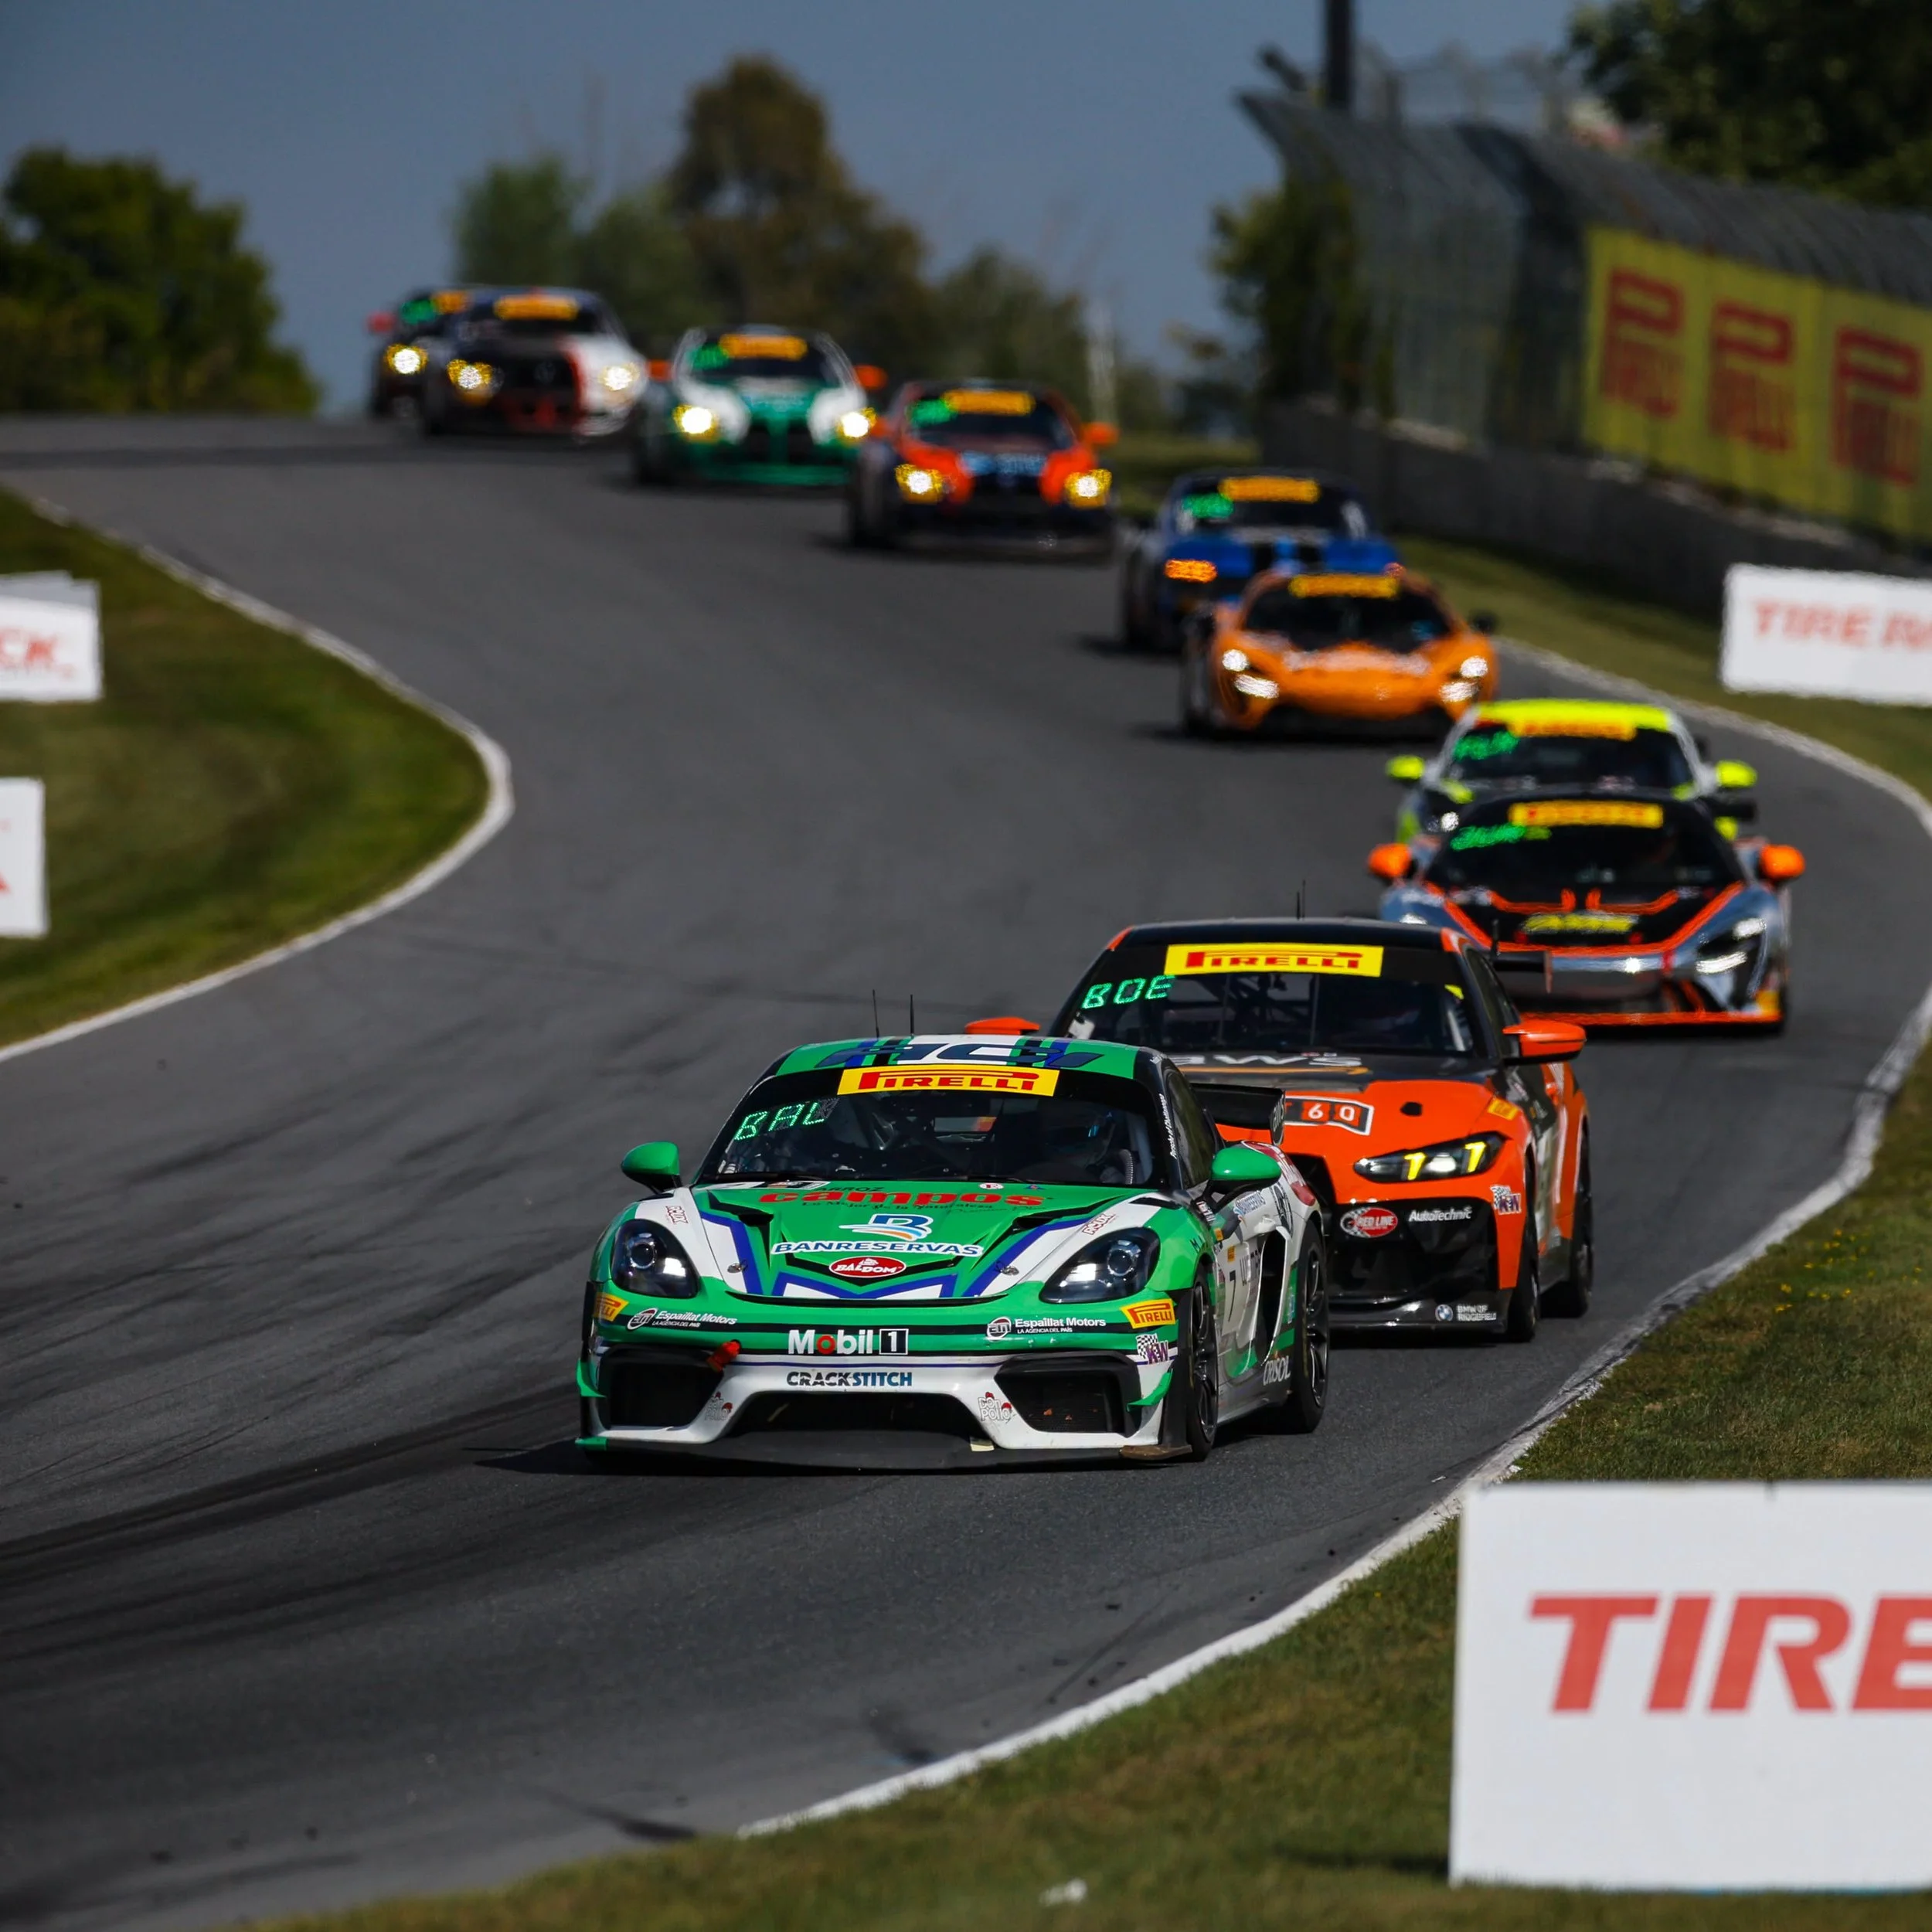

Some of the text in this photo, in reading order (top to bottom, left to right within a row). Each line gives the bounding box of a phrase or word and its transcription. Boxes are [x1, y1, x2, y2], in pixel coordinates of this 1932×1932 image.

[1752, 601, 1874, 646] TIRE
[1185, 951, 1362, 969] PIRELLI
[1082, 975, 1176, 1009] BOE
[859, 1070, 1039, 1091] PIRELLI
[733, 1102, 825, 1141] BAL
[760, 1191, 1044, 1206] campos
[774, 1242, 978, 1255] BANRESERVAS
[834, 1263, 896, 1274] BALDOM
[656, 1311, 738, 1325] Espaillat Motors
[1015, 1317, 1106, 1328] Espaillat Motors
[1129, 1303, 1172, 1323] PIRELLI
[788, 1329, 874, 1355] Mobil
[787, 1372, 913, 1387] CRACKSTITCH
[1529, 1594, 1932, 1713] TIRE
